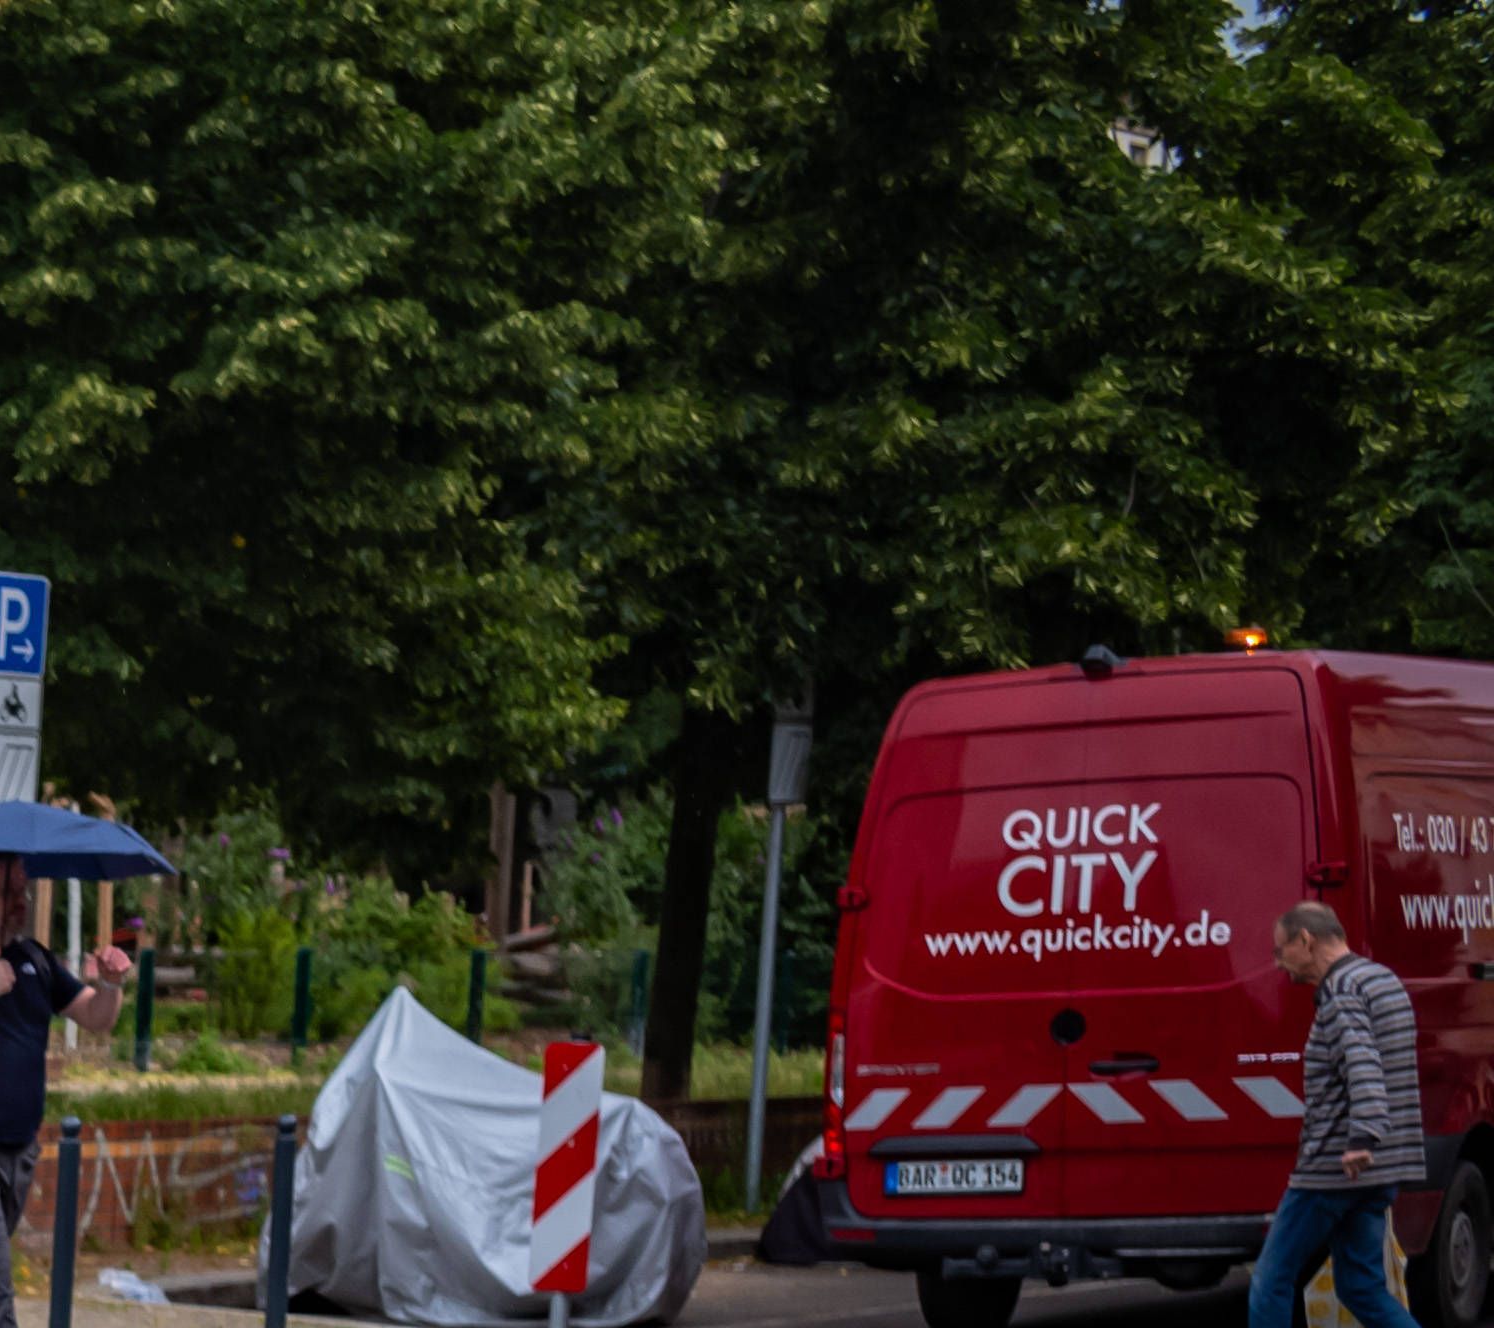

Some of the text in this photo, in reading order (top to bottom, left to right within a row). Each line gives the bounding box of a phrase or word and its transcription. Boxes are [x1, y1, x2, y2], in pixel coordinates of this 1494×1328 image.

[1002, 802, 1162, 850] QUICK
[1426, 813, 1456, 854] 030
[1470, 816, 1488, 854] 43
[996, 850, 1159, 918] CITY
[924, 908, 1232, 963] www.quickcity.de
